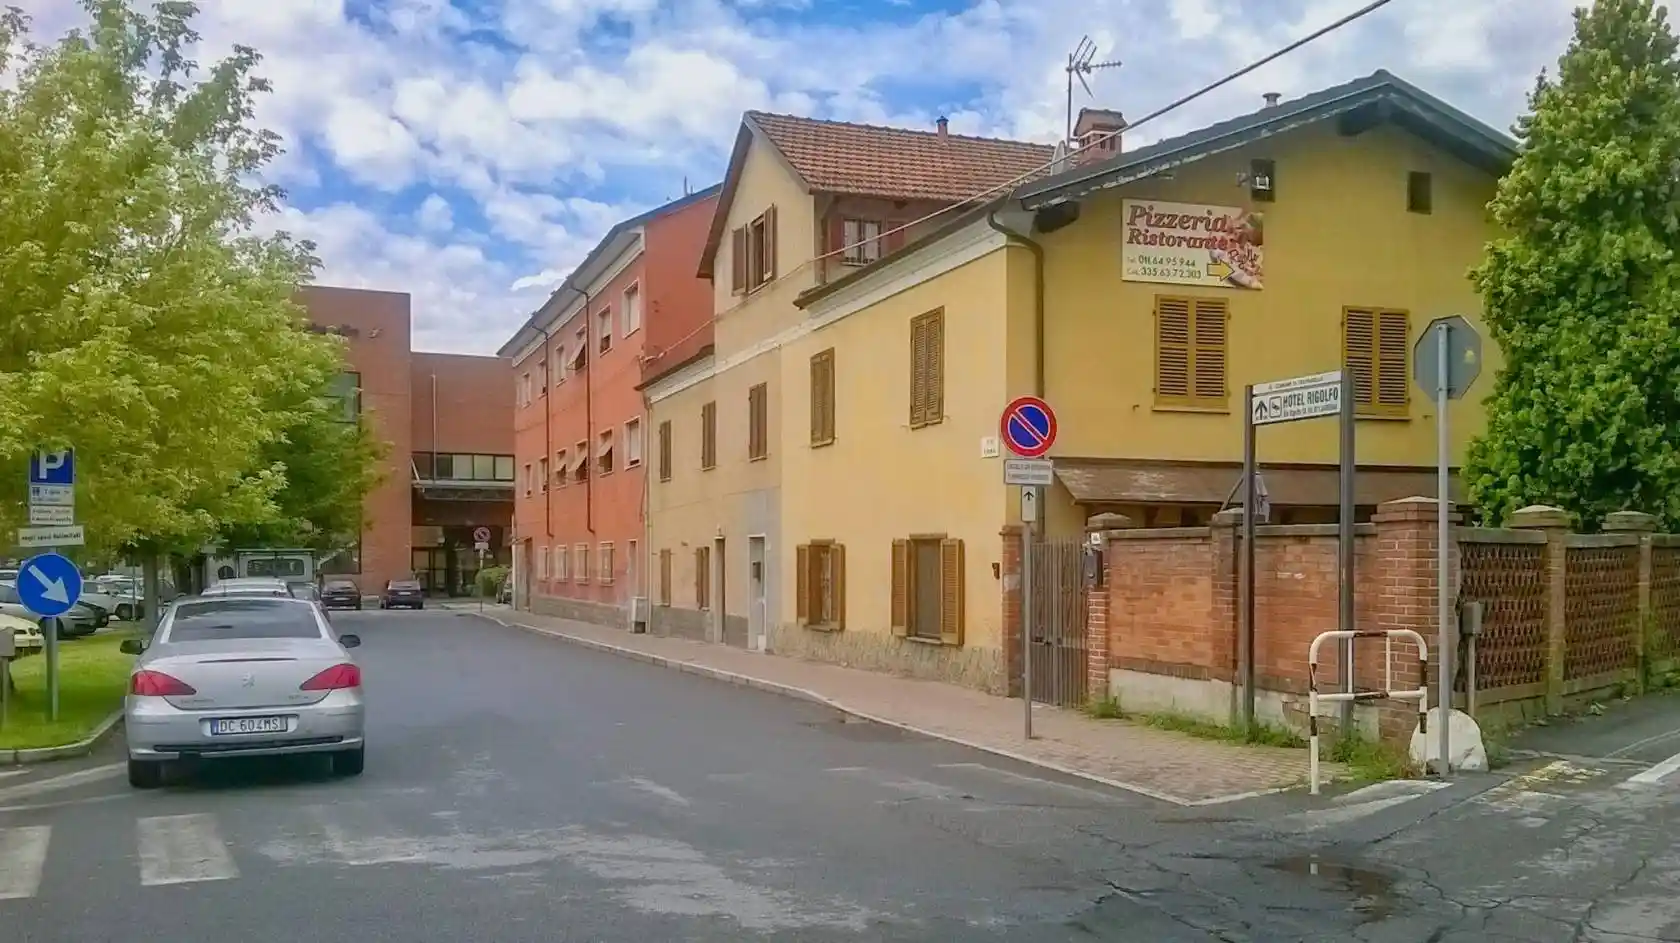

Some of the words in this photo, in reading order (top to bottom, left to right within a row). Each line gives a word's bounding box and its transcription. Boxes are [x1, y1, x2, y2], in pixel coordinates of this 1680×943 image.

[1127, 205, 1229, 232] Pizzeria
[1127, 228, 1229, 250] Ristorante
[1283, 393, 1305, 408] HOTEL
[1307, 387, 1339, 405] RIGOLFO
[39, 451, 65, 479] P
[220, 721, 234, 732] DC
[240, 718, 279, 731] 604MS
